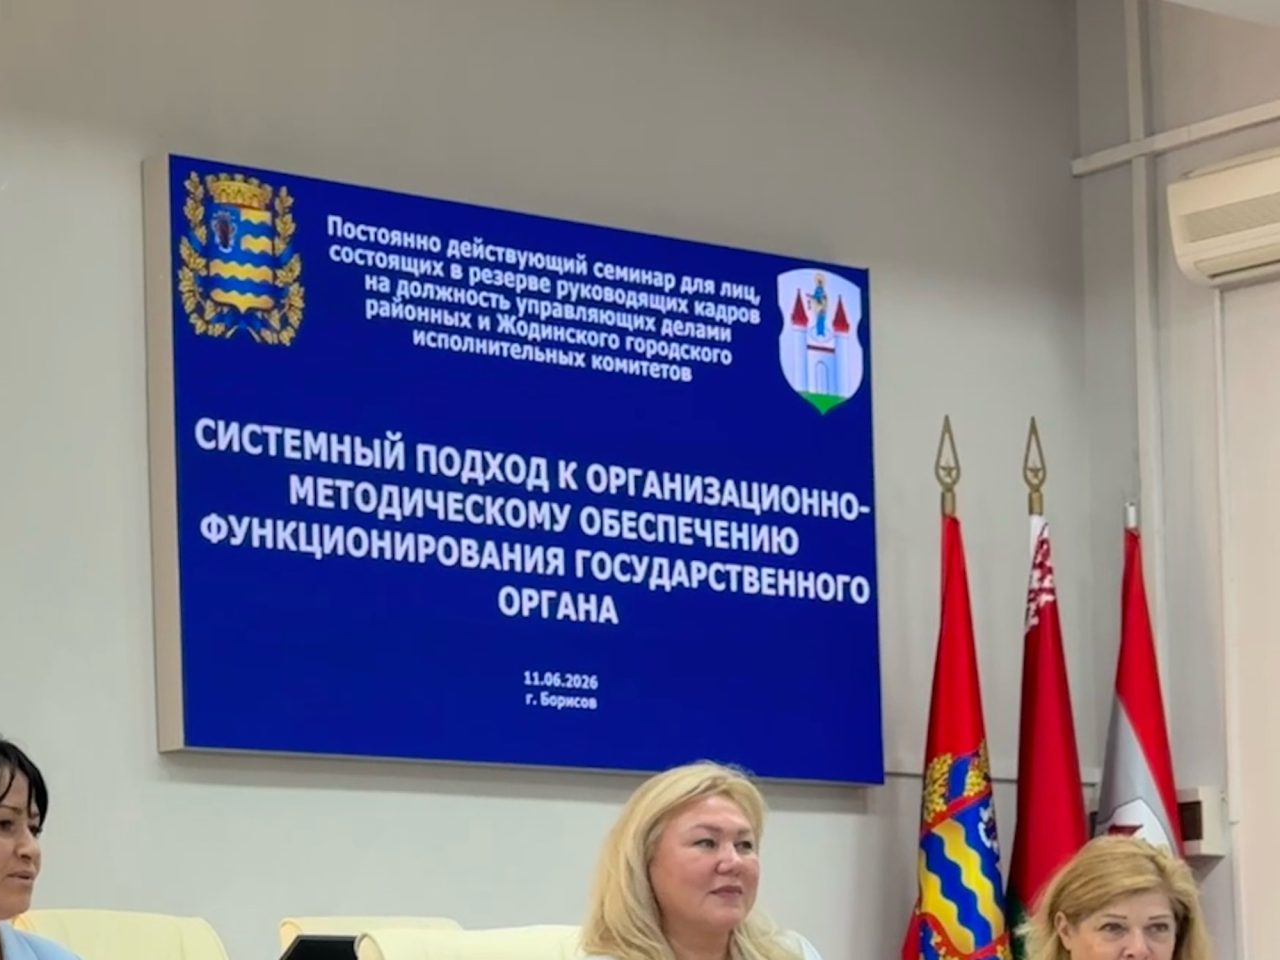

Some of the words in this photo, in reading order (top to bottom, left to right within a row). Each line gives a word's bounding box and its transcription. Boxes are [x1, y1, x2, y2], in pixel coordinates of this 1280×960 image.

[326, 214, 441, 252] Постоянно
[446, 236, 588, 276] действующий
[593, 261, 676, 292] семинар
[680, 276, 715, 295] для
[720, 281, 761, 306] лиц,
[329, 244, 444, 277] состоящих
[450, 263, 463, 280] в
[469, 266, 551, 294] резерве
[556, 278, 688, 314] руководящих
[694, 300, 761, 325] кадров
[365, 274, 391, 293] на
[395, 279, 511, 311] должность
[516, 296, 656, 332] управляющих
[660, 317, 732, 343] делами
[365, 297, 472, 329] районных
[477, 314, 491, 331] и
[497, 313, 620, 350] Жодинского
[625, 335, 732, 366] городского
[412, 329, 586, 368] исполнительных
[591, 354, 693, 383] комитетов
[194, 417, 406, 471] СИСТЕМНЫЙ
[415, 443, 550, 493] ПОДХОД
[557, 460, 578, 491] К
[586, 463, 871, 521] ОРГАНИЗАЦИОННО-
[289, 474, 571, 532] МЕТОДИЧЕСКОМУ
[579, 506, 799, 556] ОБЕСПЕЧЕНИЮ
[199, 512, 565, 577] ФУНКЦИОНИРОВАНИЯ
[574, 548, 871, 605] ГОСУДАРСТВЕННОГО
[498, 586, 619, 625] ОРГАНА
[523, 670, 599, 690] 11.06.2026
[525, 692, 537, 706] г.
[540, 690, 598, 710] Борисов
